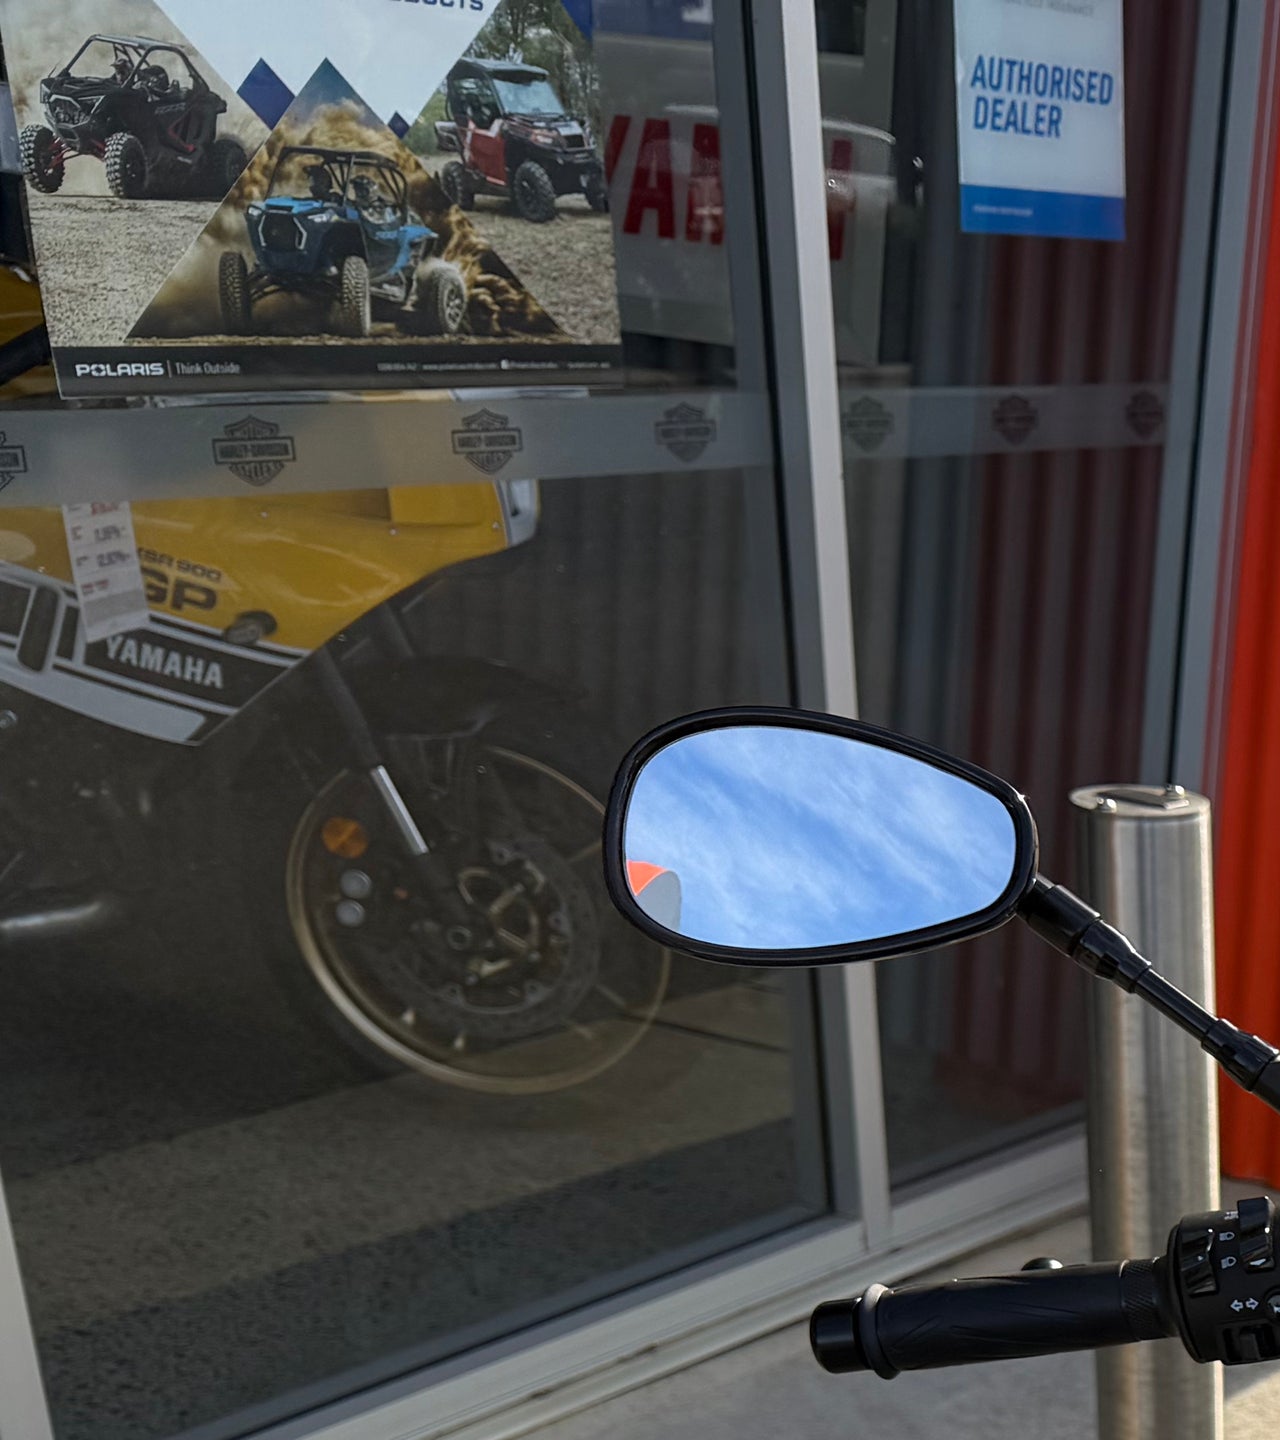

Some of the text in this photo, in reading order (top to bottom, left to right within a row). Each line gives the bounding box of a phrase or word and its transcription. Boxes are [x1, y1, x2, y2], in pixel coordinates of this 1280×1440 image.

[970, 54, 1115, 106] AUTHORISED
[973, 95, 1064, 139] DEALER
[75, 361, 241, 377] POLARIS Think Outside
[176, 559, 222, 583] 900
[106, 634, 224, 689] YAMAHA
